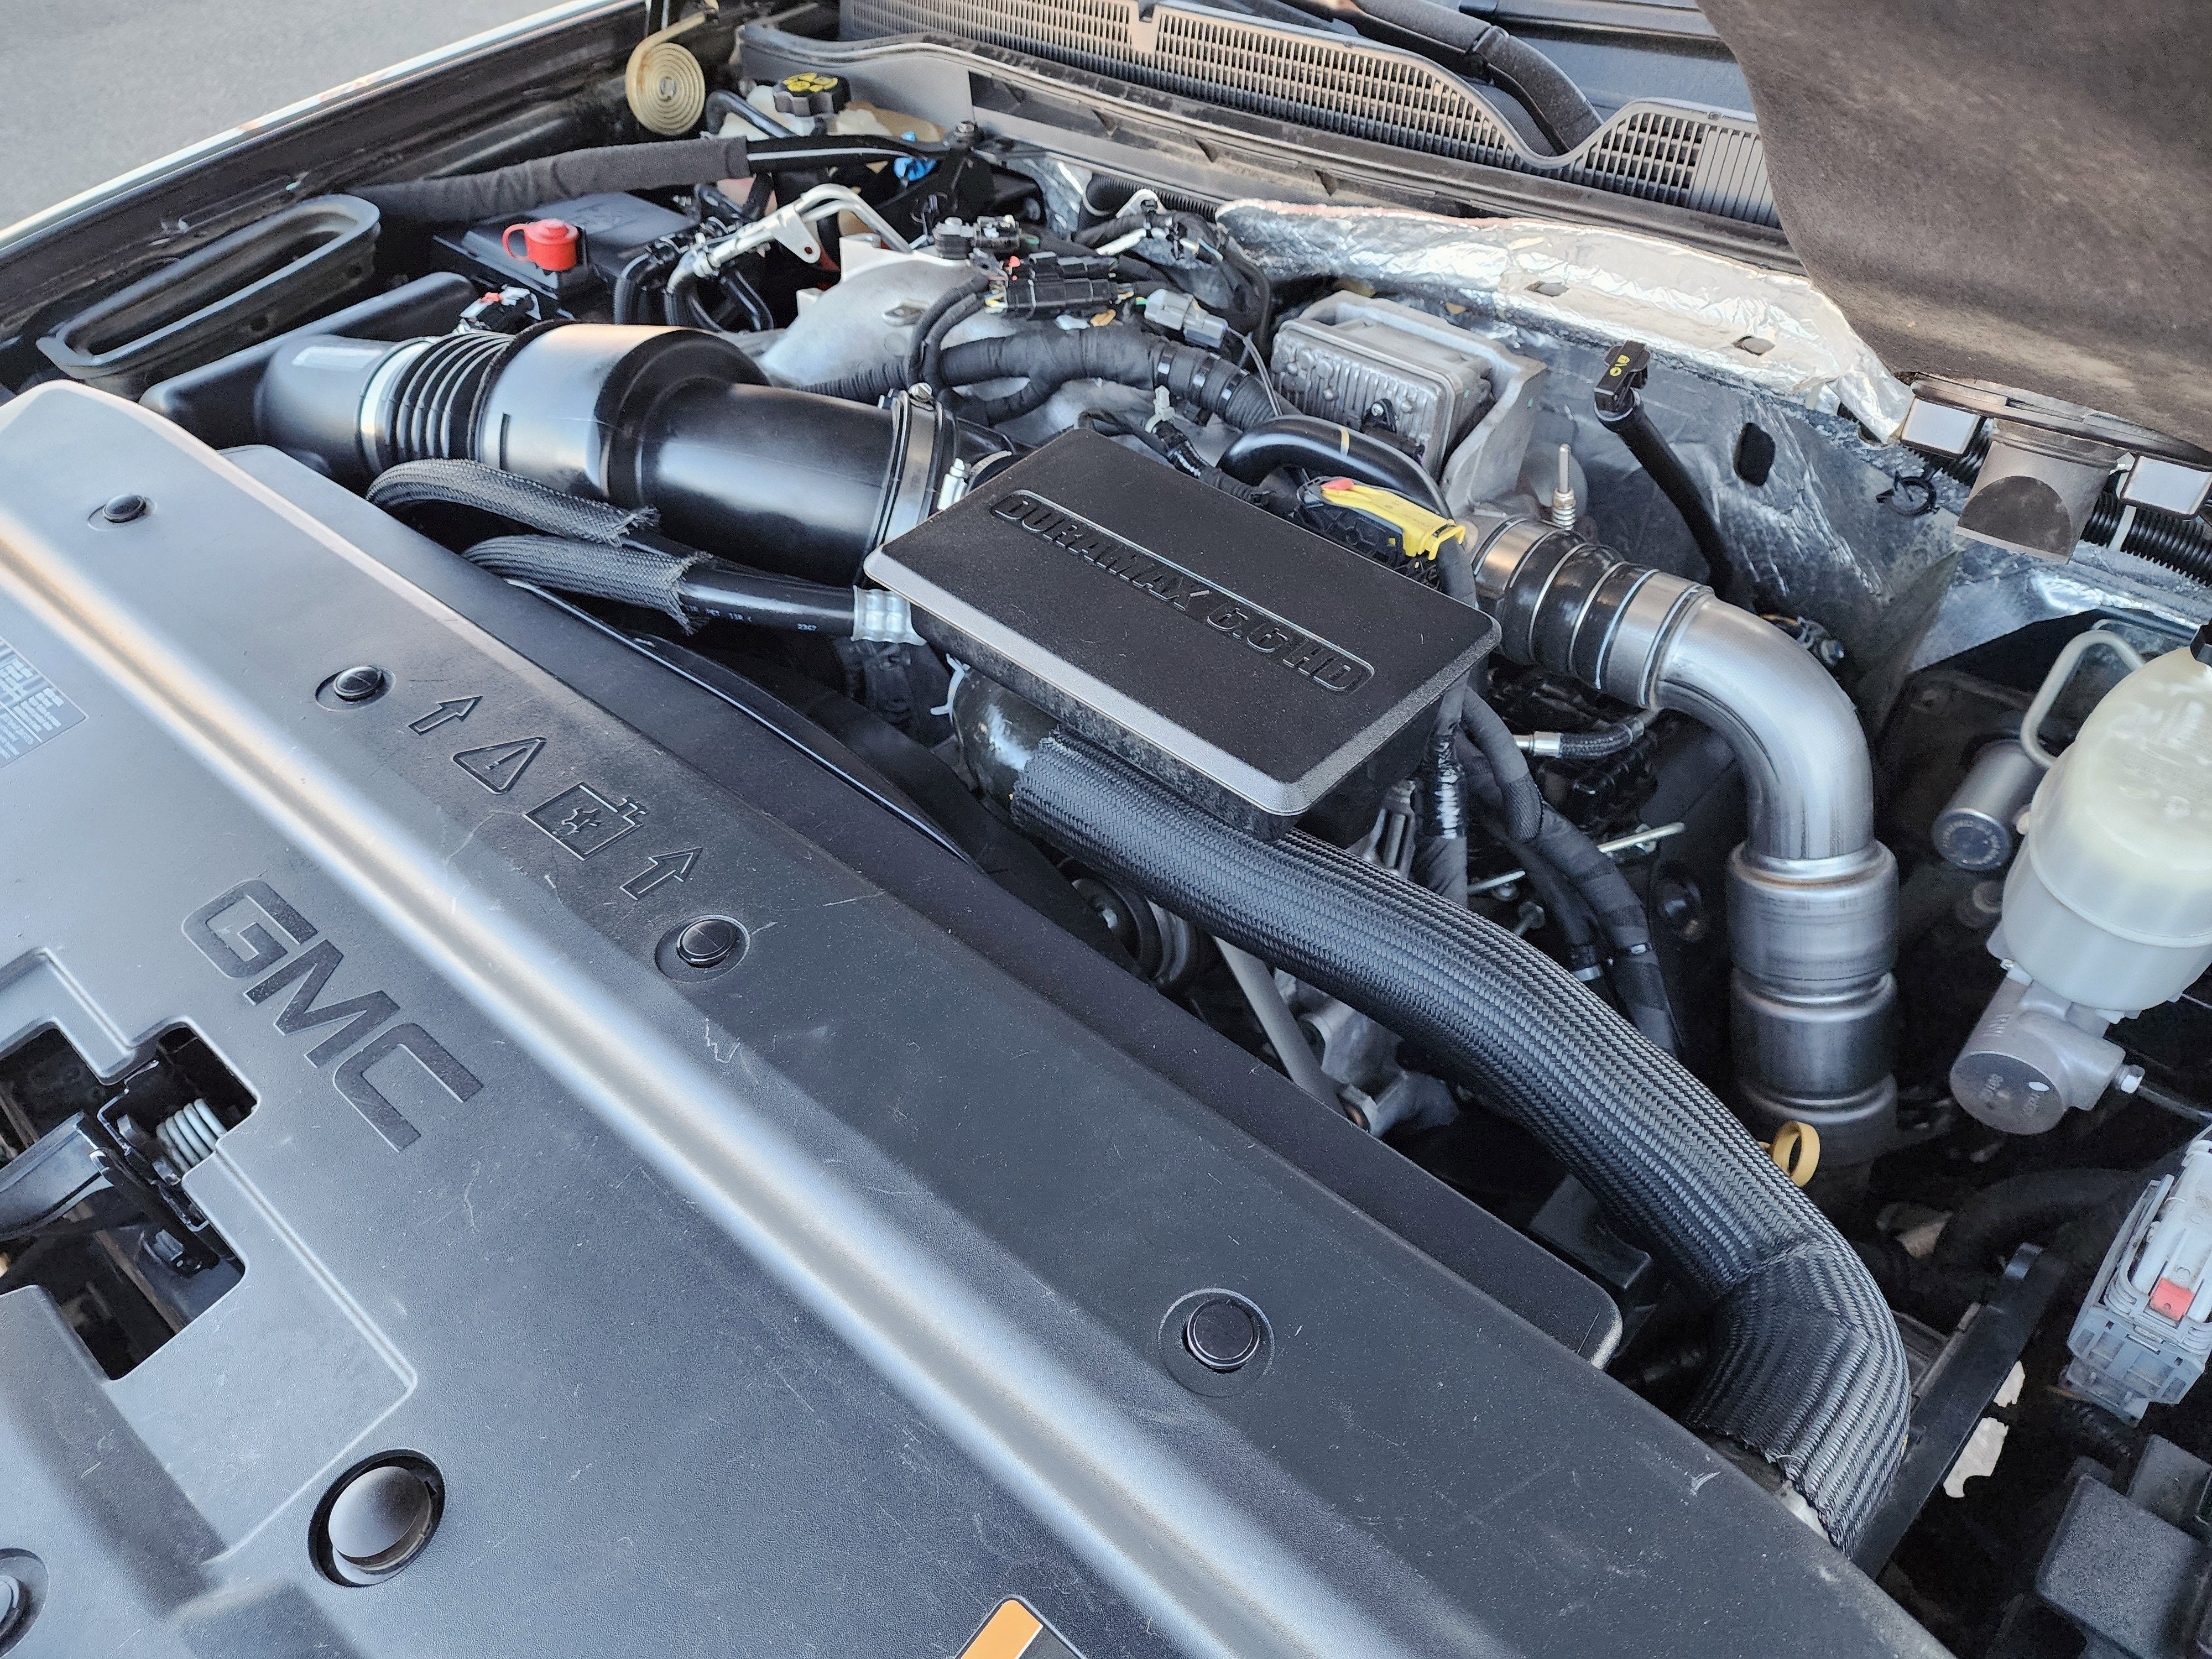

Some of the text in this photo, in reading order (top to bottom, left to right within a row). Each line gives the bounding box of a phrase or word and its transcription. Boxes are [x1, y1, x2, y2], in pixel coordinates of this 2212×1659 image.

[994, 493, 1363, 692] DURAMAX 6.6 HD
[181, 878, 484, 1153] GMC
